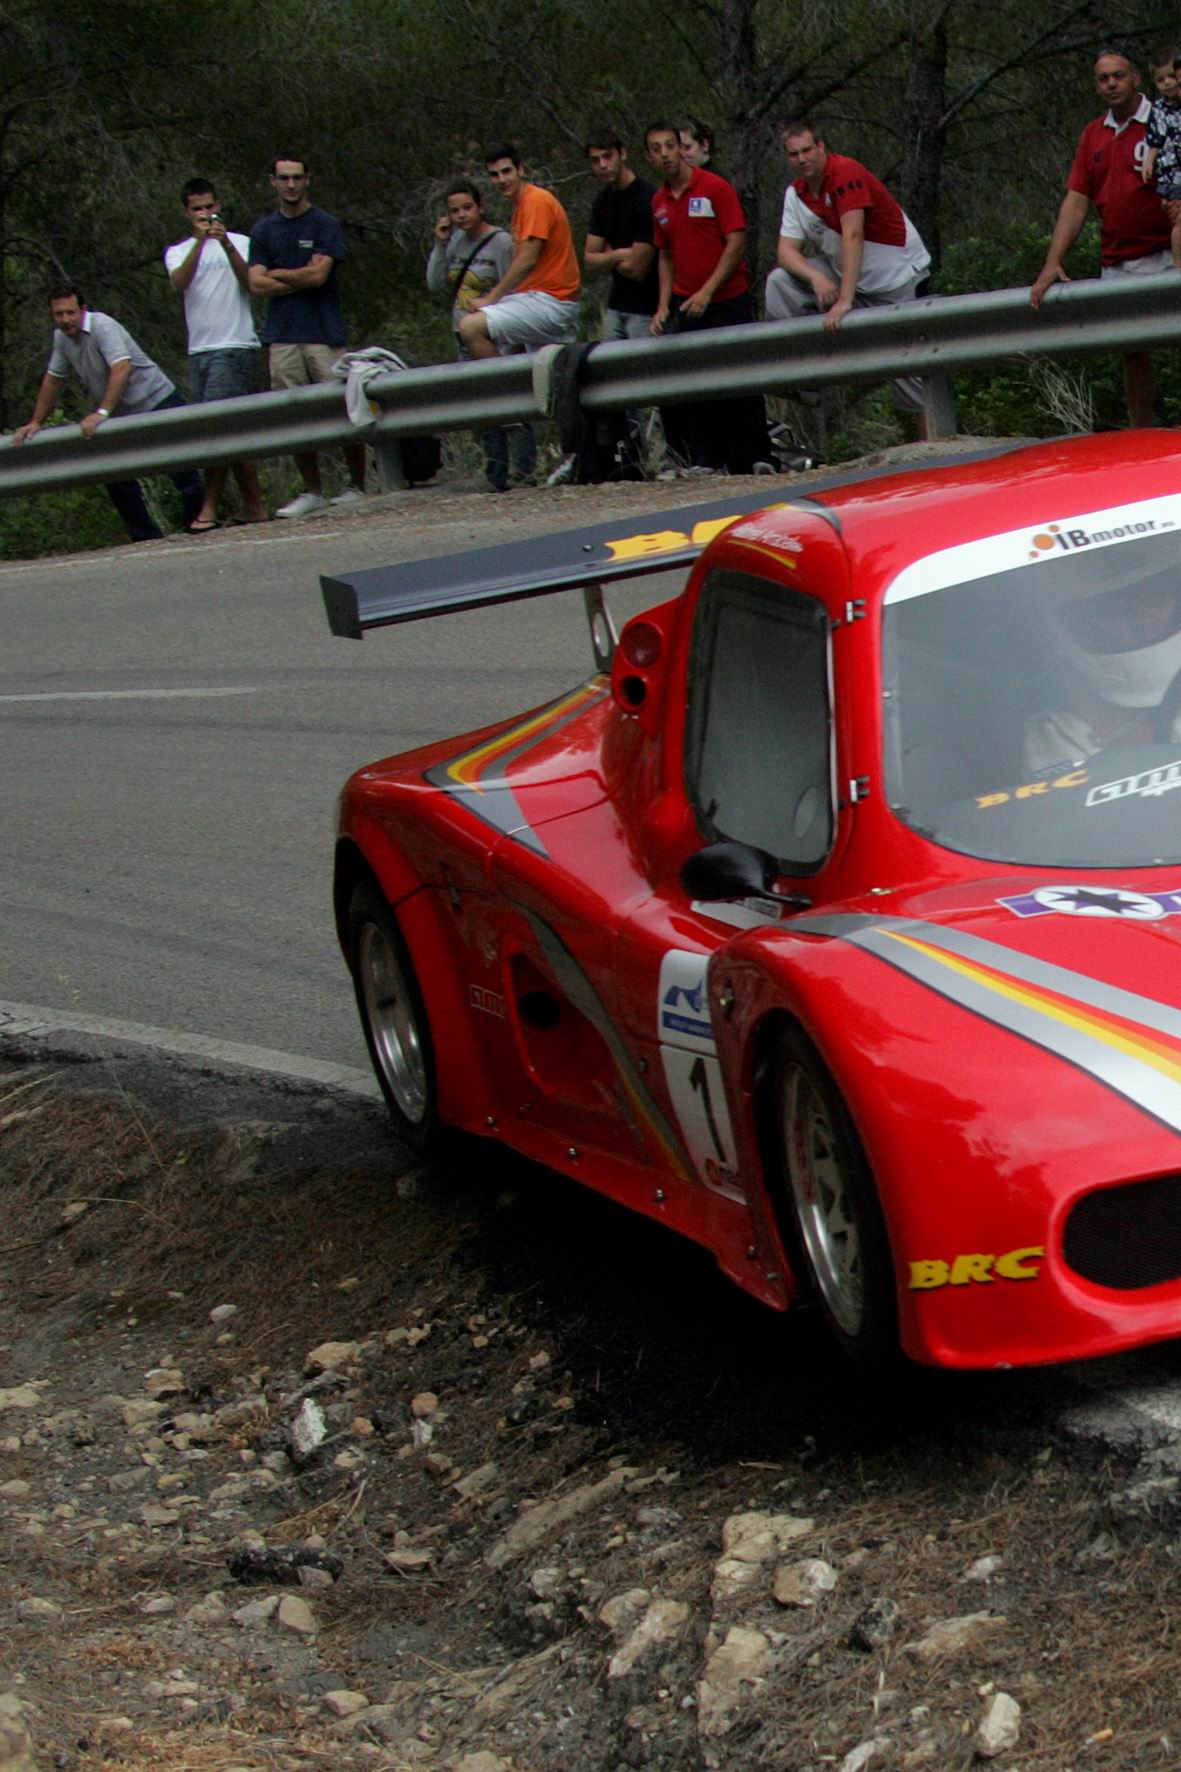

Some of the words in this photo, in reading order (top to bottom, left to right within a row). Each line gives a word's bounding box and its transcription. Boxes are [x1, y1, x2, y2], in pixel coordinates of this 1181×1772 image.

[975, 768, 1090, 809] BRC
[690, 1057, 728, 1162] 1
[908, 1246, 1046, 1291] BRC
